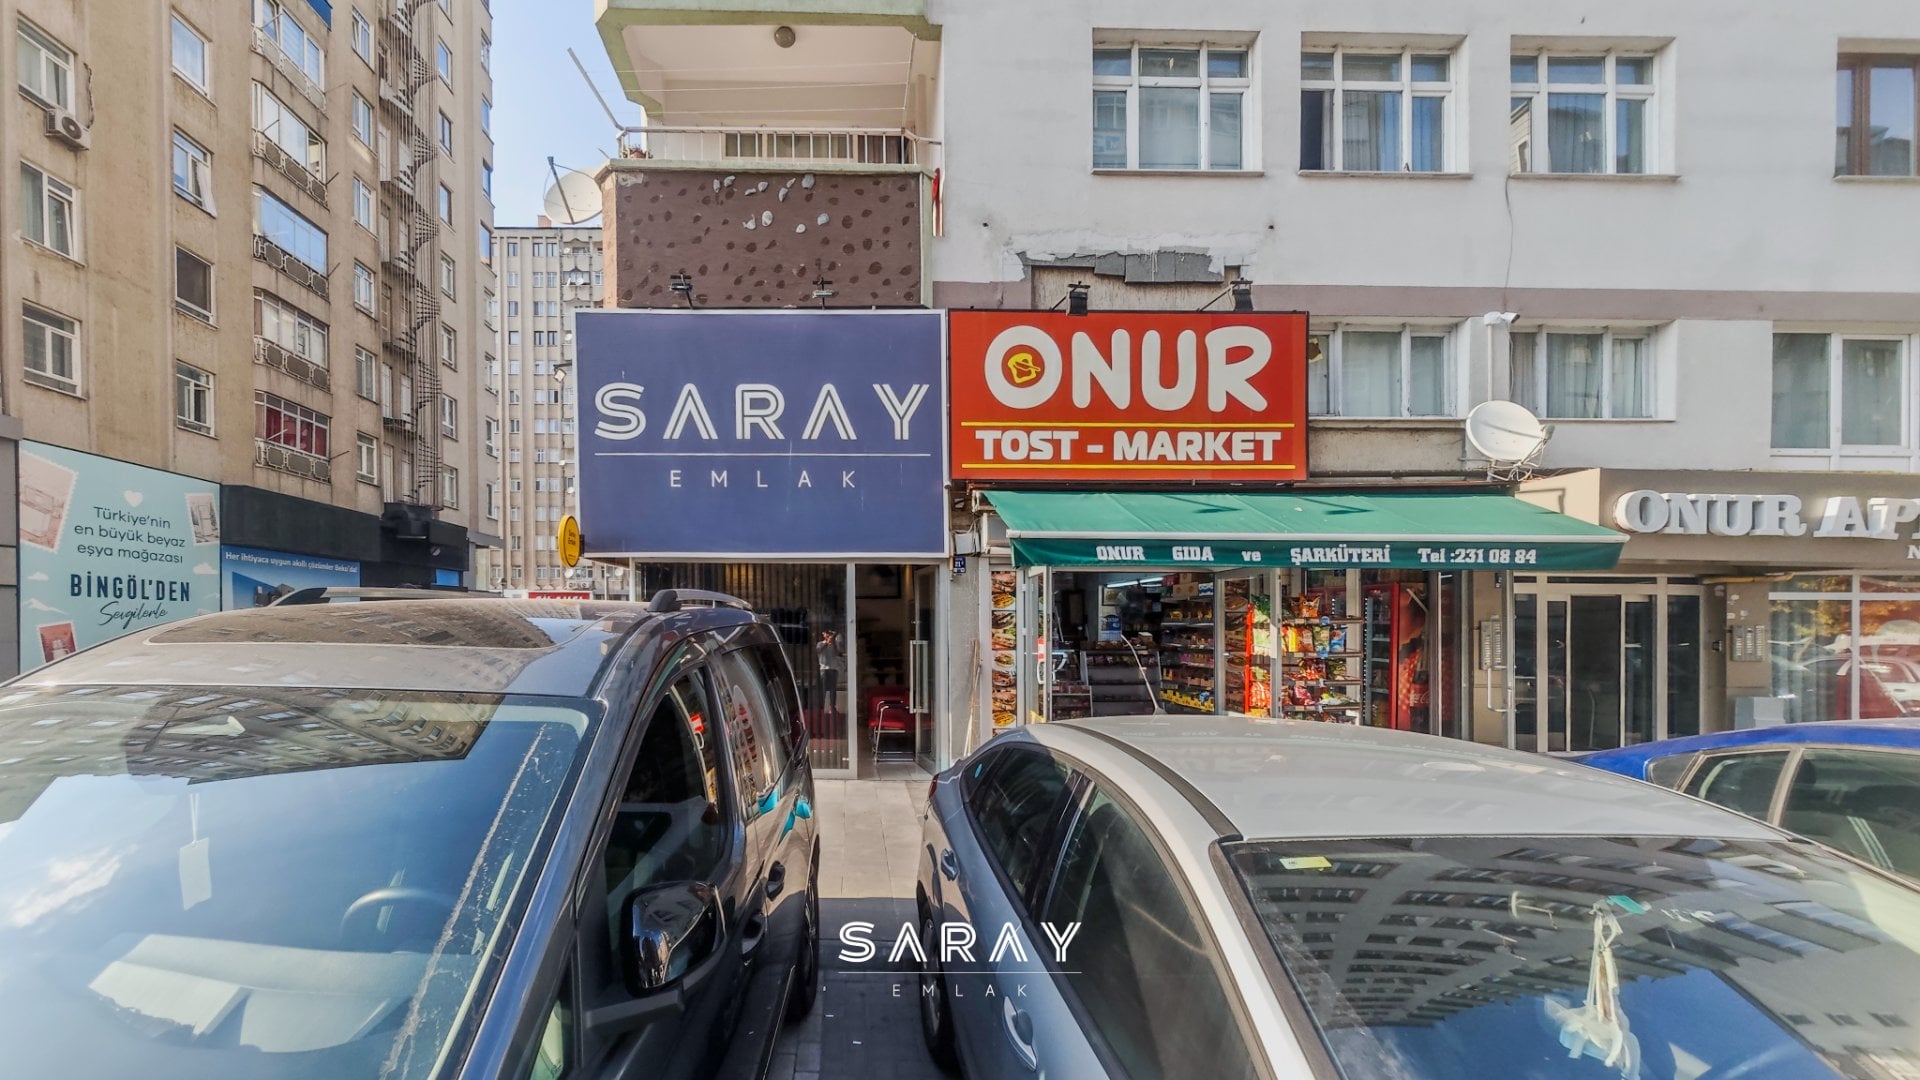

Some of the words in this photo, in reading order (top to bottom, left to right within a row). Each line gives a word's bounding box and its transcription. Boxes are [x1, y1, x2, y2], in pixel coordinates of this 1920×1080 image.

[984, 325, 1273, 412] ONUR
[594, 382, 930, 441] SARAY
[975, 430, 1079, 460] TOST
[1113, 430, 1282, 461] MARKET
[670, 470, 856, 488] EMLAK
[93, 506, 171, 528] Türkiye'nin
[1614, 489, 1807, 537] ONUR
[74, 525, 94, 536] en
[98, 525, 143, 542] büyük
[147, 532, 185, 548] beyaz
[77, 544, 113, 557] eşya
[118, 548, 183, 563] mağazası
[225, 552, 239, 561] Her
[1096, 546, 1145, 561] ONUR
[1172, 546, 1214, 561] GIDA
[1241, 549, 1261, 562] ve
[1290, 544, 1390, 565] ŞARKÜTERİ
[1418, 548, 1446, 563] Tel
[1489, 549, 1511, 563] 08
[1515, 549, 1537, 564] 84
[70, 571, 190, 602] BİNGÖL'DEN
[98, 601, 168, 630] Sevgilerle
